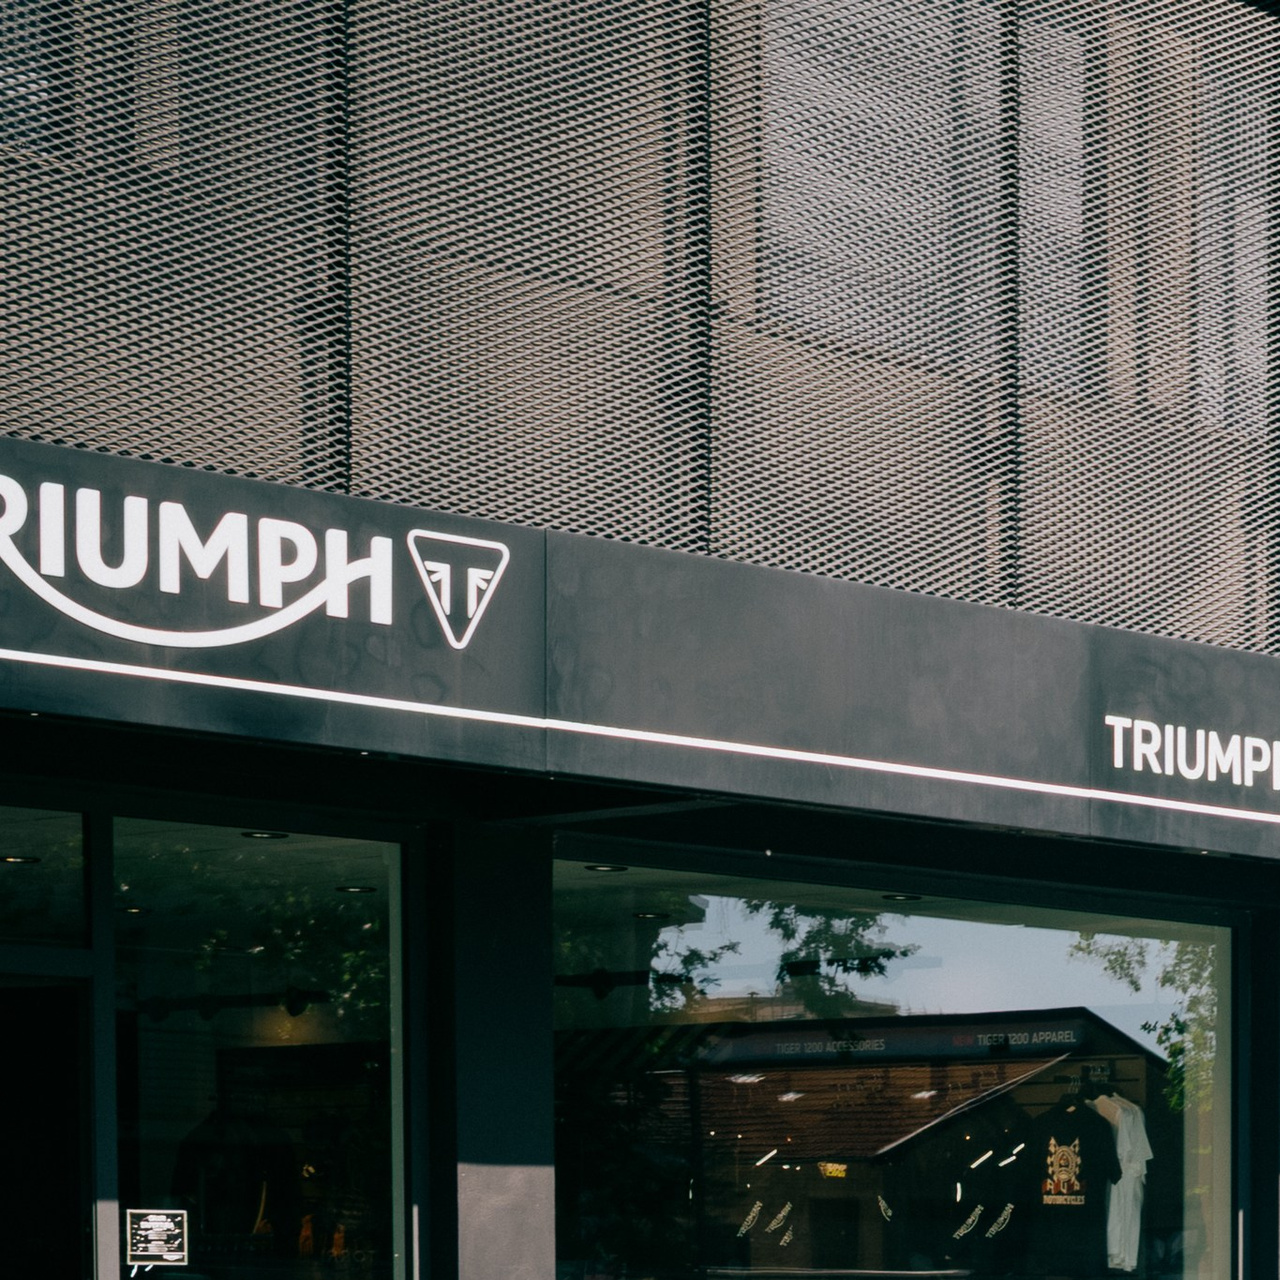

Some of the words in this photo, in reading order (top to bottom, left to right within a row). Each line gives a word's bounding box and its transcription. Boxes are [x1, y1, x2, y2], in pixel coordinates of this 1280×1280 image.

[977, 1034, 1005, 1046] TIGER
[1008, 1033, 1029, 1045] 1200
[1031, 1030, 1077, 1043] APPAREL
[776, 1043, 800, 1054] TIGER
[803, 1042, 823, 1053] 1200
[826, 1039, 886, 1052] ACCESSORIES
